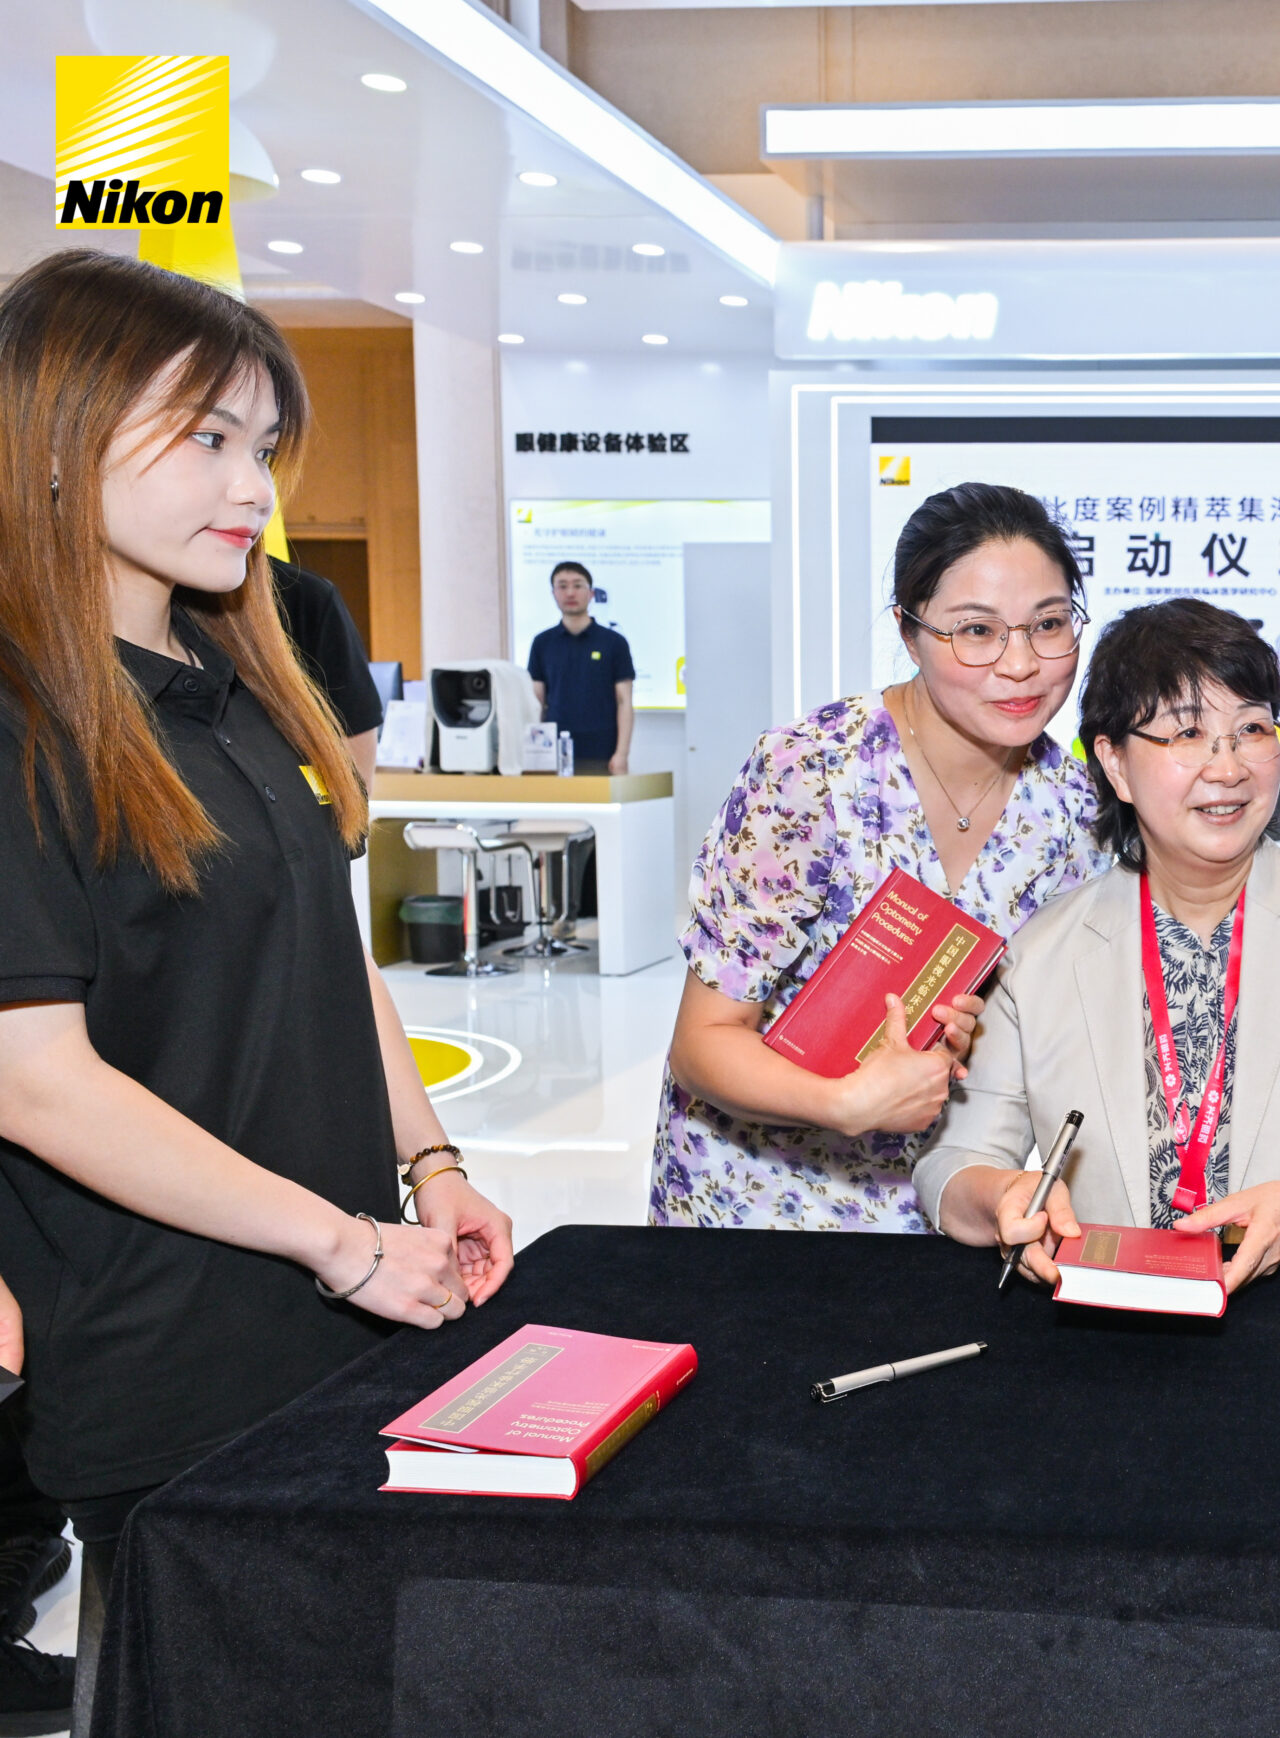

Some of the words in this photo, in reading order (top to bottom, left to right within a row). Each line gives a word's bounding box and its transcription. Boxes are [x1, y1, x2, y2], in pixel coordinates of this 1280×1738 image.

[807, 279, 999, 341] Nikon
[515, 432, 690, 453] 眼健康设备体验区
[879, 902, 923, 935] Optometry
[888, 890, 918, 915] Manual
[918, 912, 930, 922] of
[871, 911, 915, 946] Procedures
[510, 1420, 583, 1436] Optometry
[519, 1413, 591, 1427] Procedures
[523, 1430, 575, 1444] Manual
